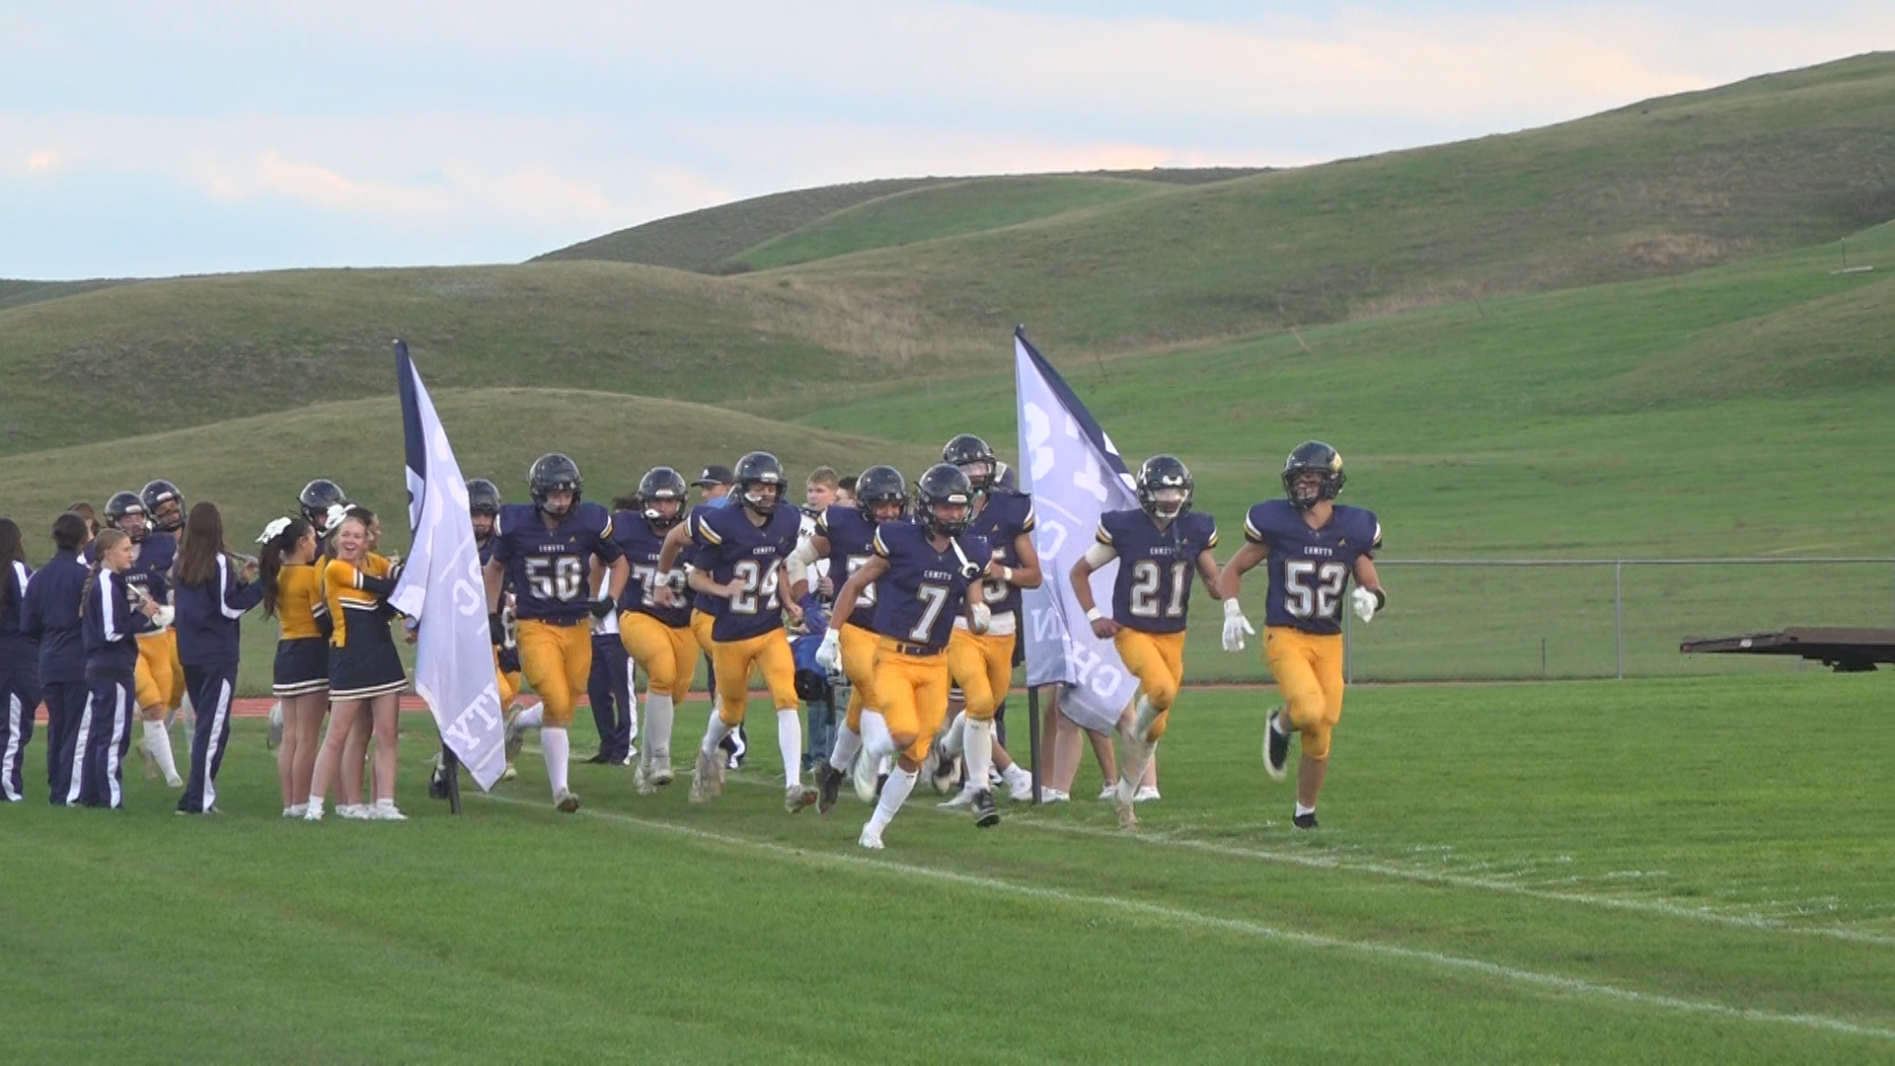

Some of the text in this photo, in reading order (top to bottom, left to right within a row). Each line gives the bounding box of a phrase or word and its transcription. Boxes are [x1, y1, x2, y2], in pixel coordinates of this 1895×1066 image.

[730, 558, 781, 614] 24
[909, 582, 950, 643] 7
[1130, 559, 1187, 617] 21
[1284, 558, 1347, 618] 52
